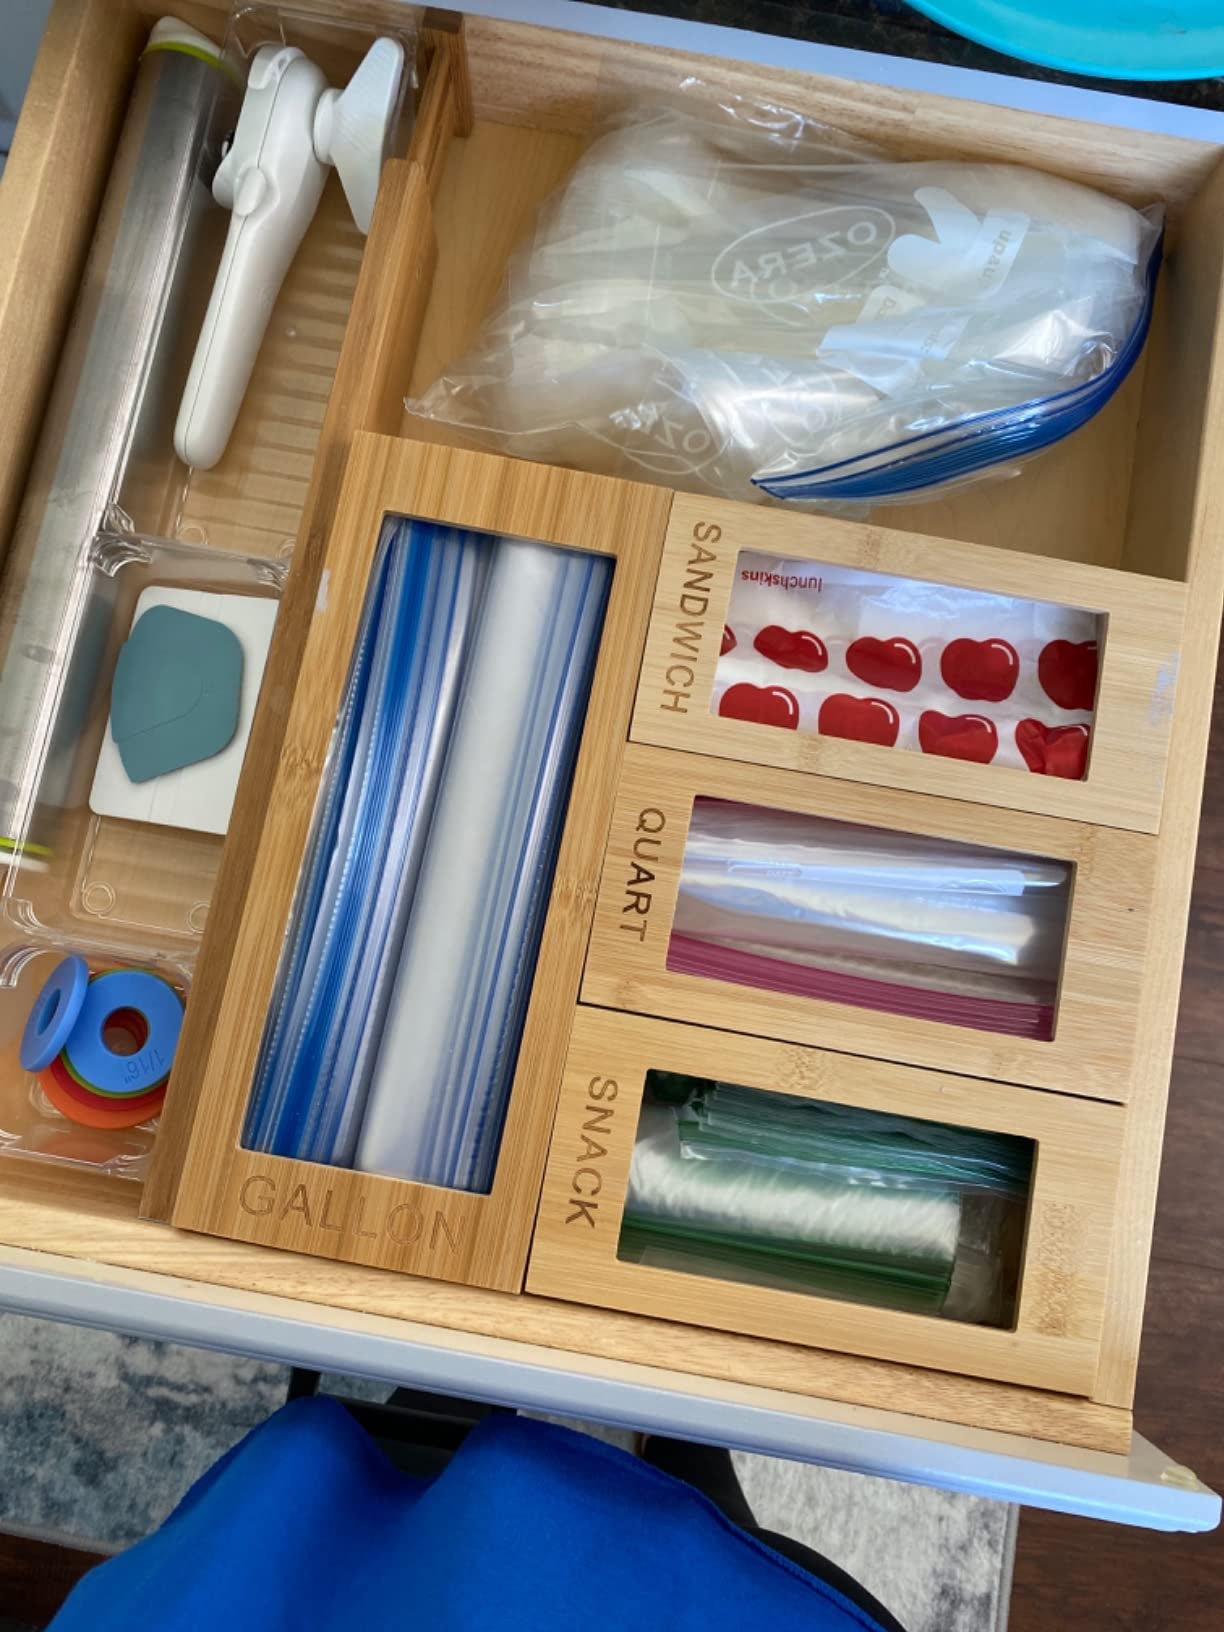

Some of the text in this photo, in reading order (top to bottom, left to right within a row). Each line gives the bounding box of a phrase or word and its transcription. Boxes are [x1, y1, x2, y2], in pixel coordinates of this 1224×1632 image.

[660, 520, 722, 715] SANDWICH
[740, 569, 823, 593] lunchskins
[619, 806, 667, 942] QUART
[238, 1174, 466, 1254] GALLON
[564, 1075, 619, 1230] SNACK
